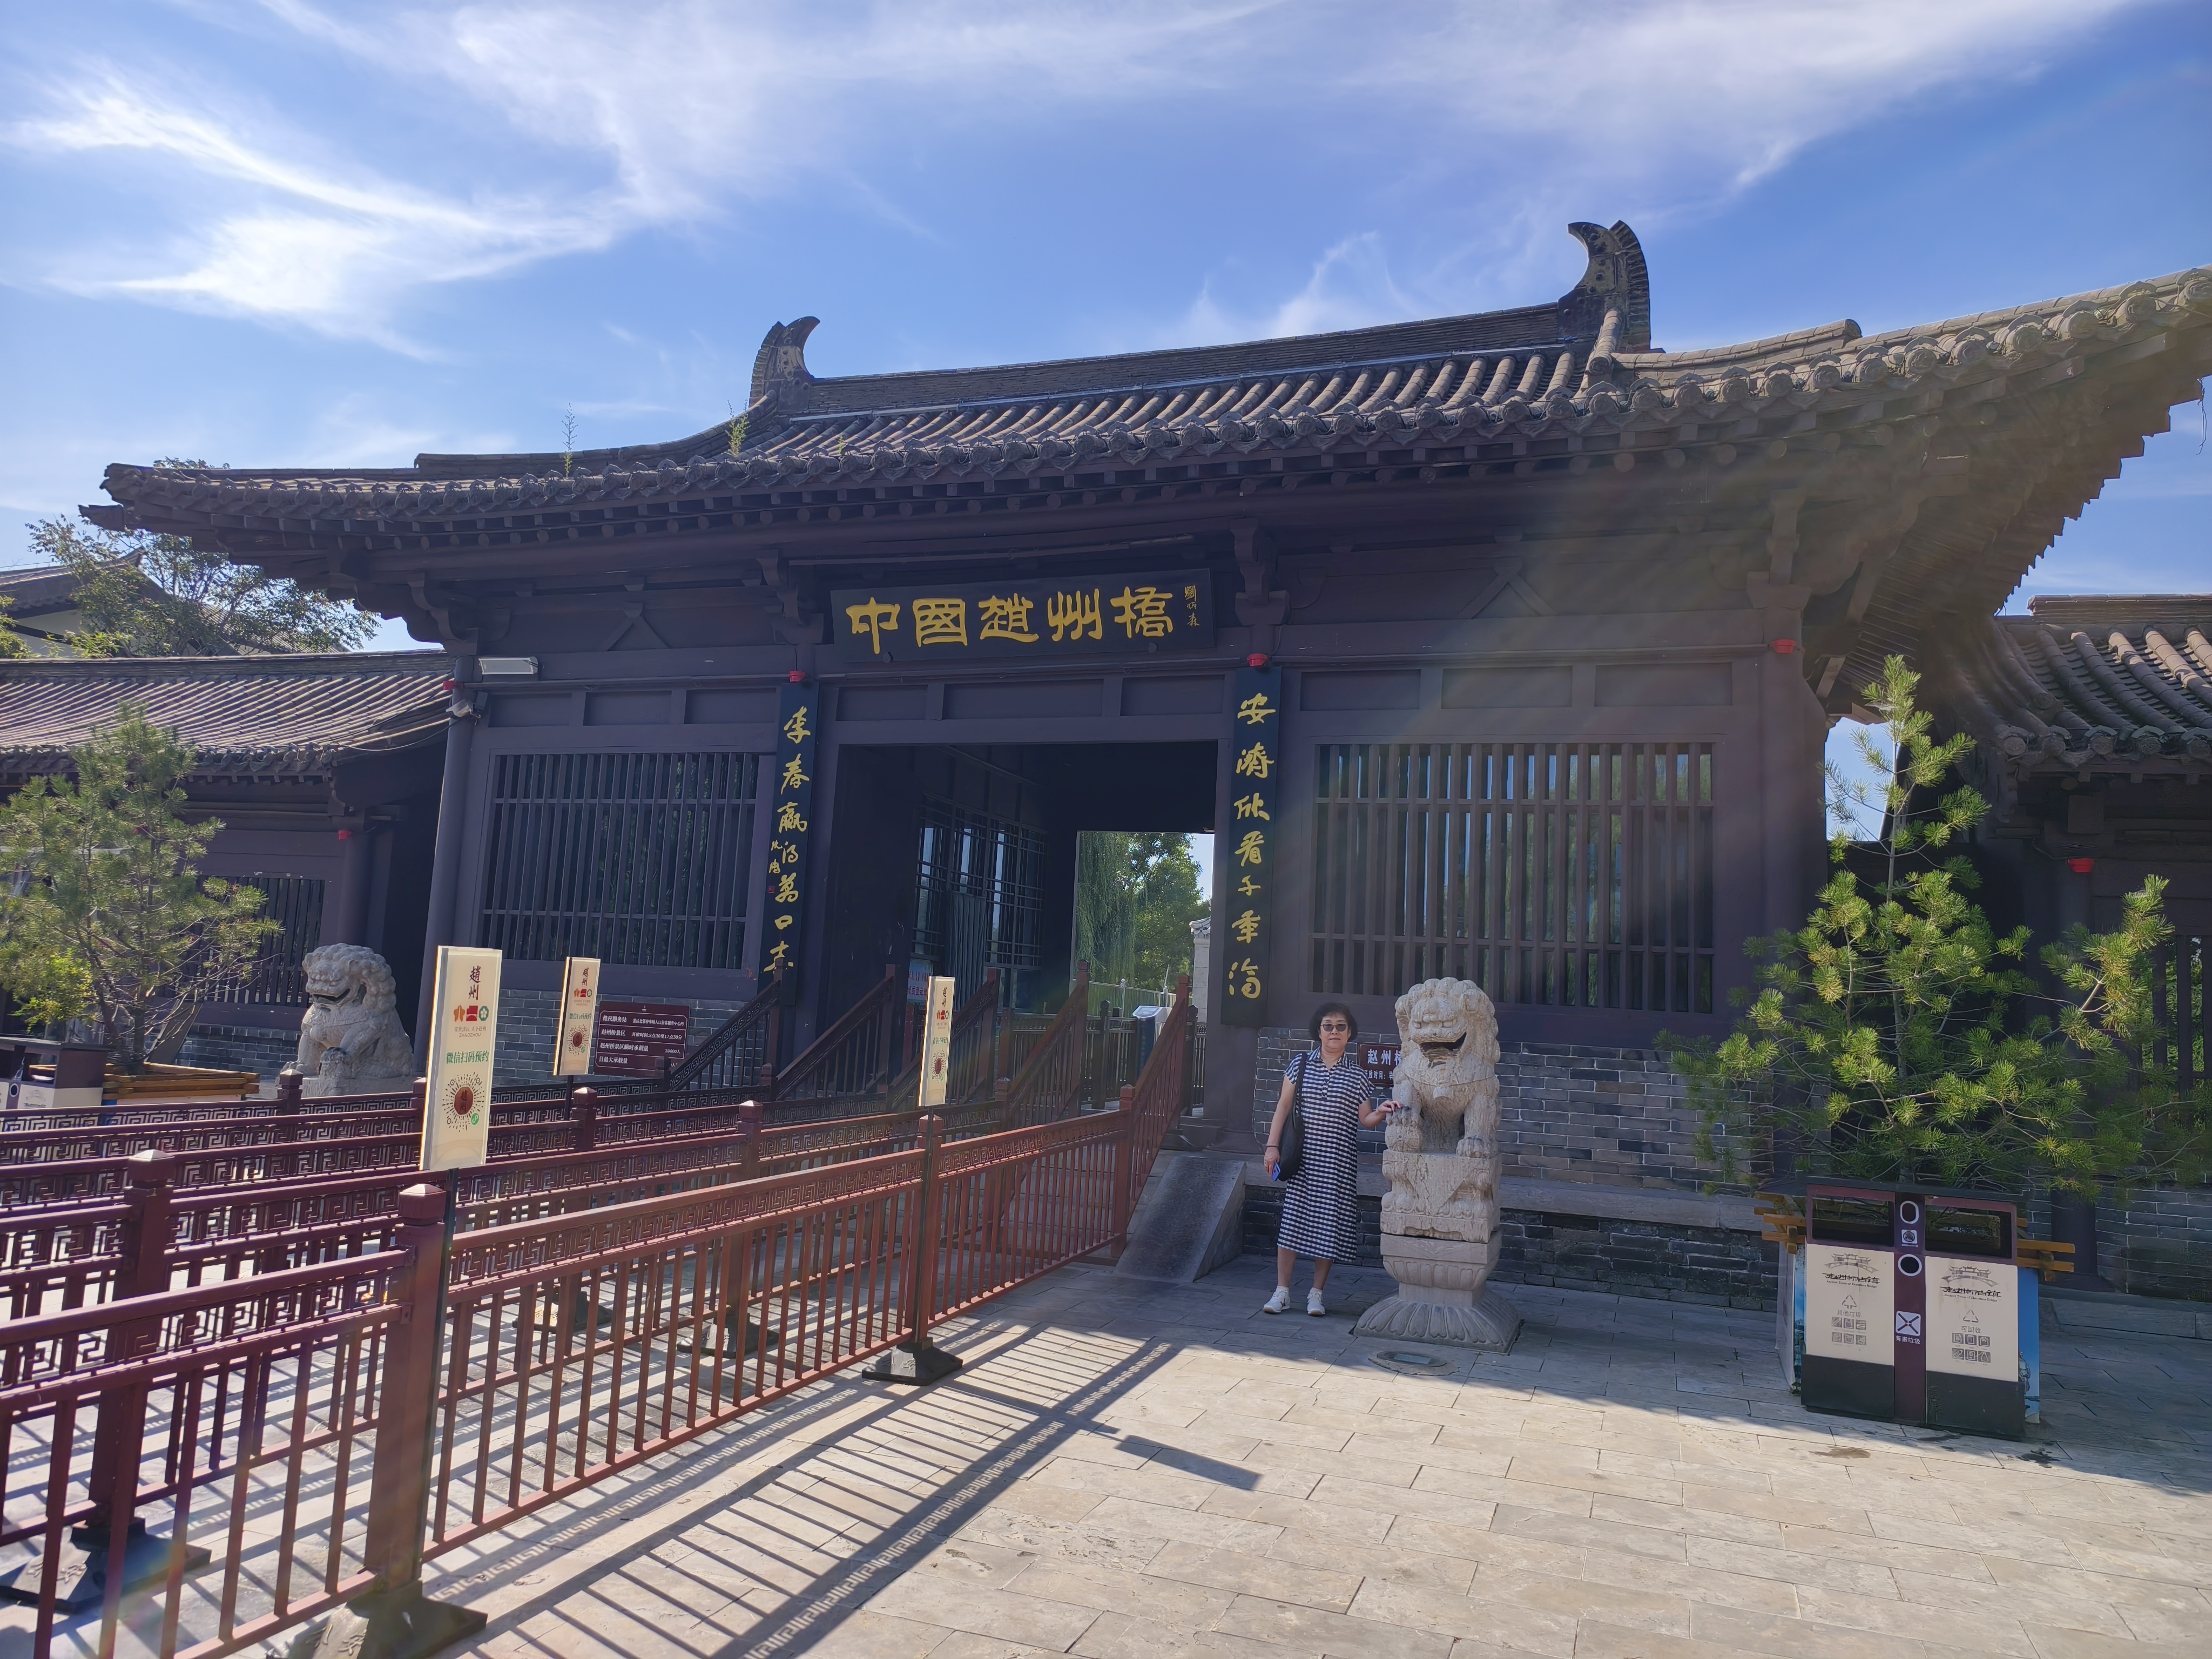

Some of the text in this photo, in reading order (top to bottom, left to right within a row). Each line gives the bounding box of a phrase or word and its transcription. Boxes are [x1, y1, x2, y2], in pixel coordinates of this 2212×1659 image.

[447, 1050, 489, 1064] 微信扫码预约
[1896, 1335, 1920, 1345] 有害垃圾
